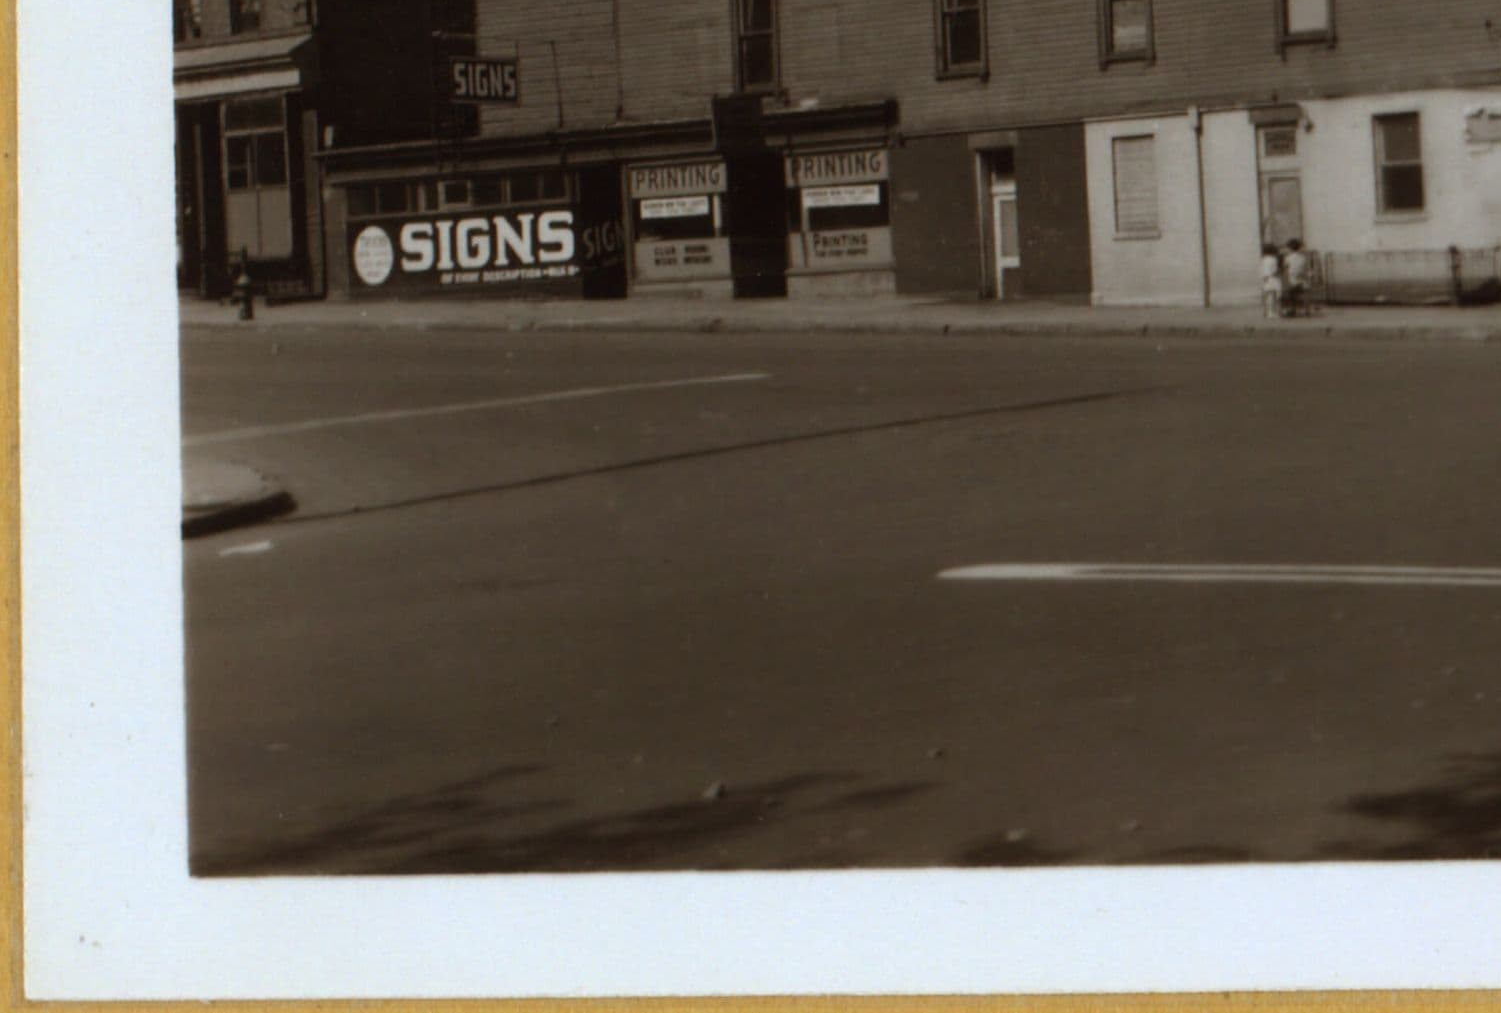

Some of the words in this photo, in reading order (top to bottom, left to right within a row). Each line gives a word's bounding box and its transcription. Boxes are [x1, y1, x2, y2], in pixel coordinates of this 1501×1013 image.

[453, 62, 516, 97] SIGNS
[635, 164, 721, 191] PRINTING
[791, 152, 881, 179] PRINTING
[399, 209, 575, 274] SIGNS
[814, 232, 868, 248] PRINTING
